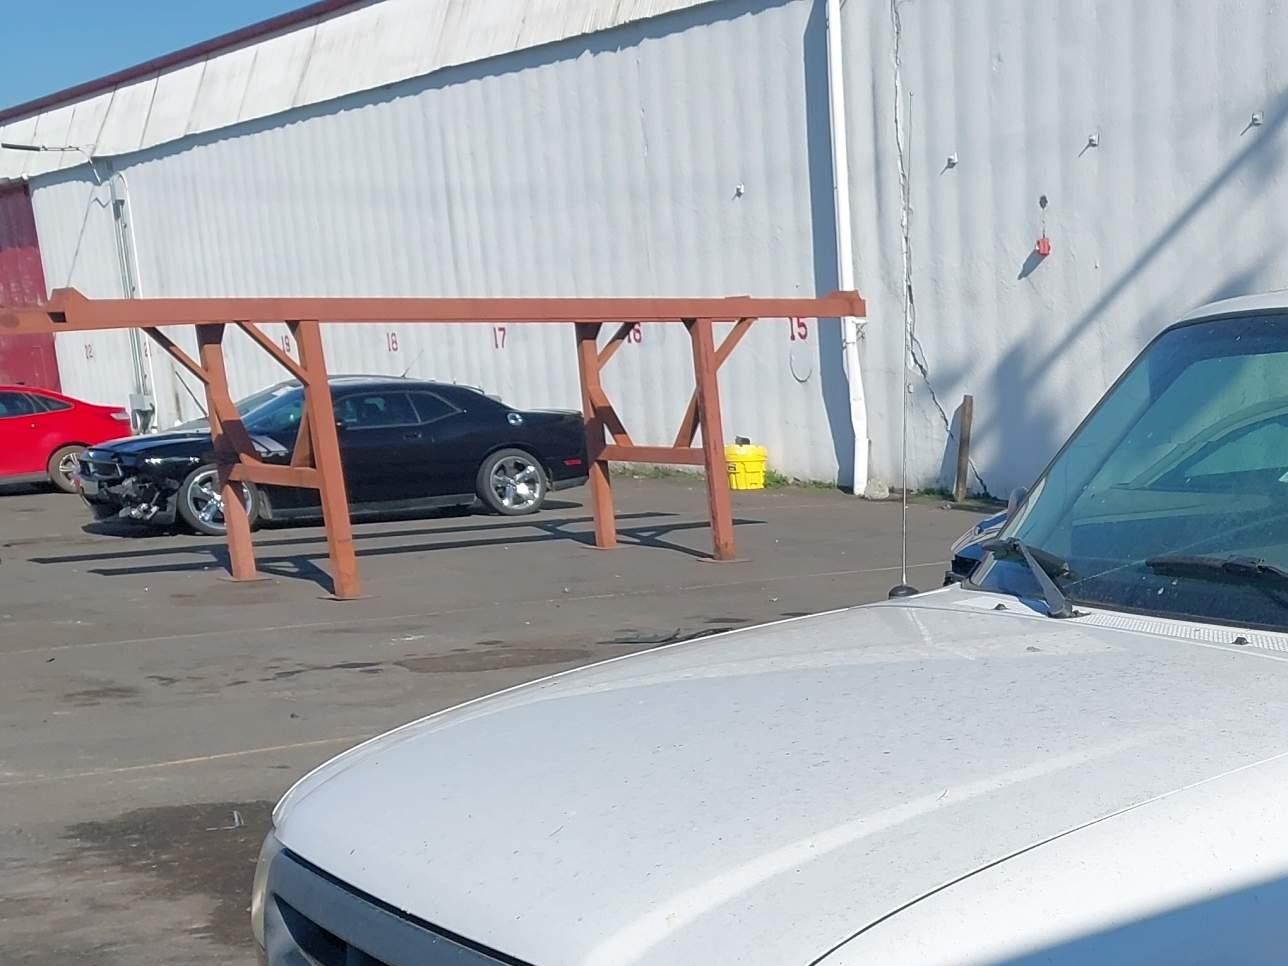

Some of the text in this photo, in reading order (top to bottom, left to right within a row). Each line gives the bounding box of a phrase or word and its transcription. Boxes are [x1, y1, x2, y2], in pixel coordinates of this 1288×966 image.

[492, 327, 506, 349] 17
[788, 317, 808, 341] 15
[386, 332, 399, 352] 18
